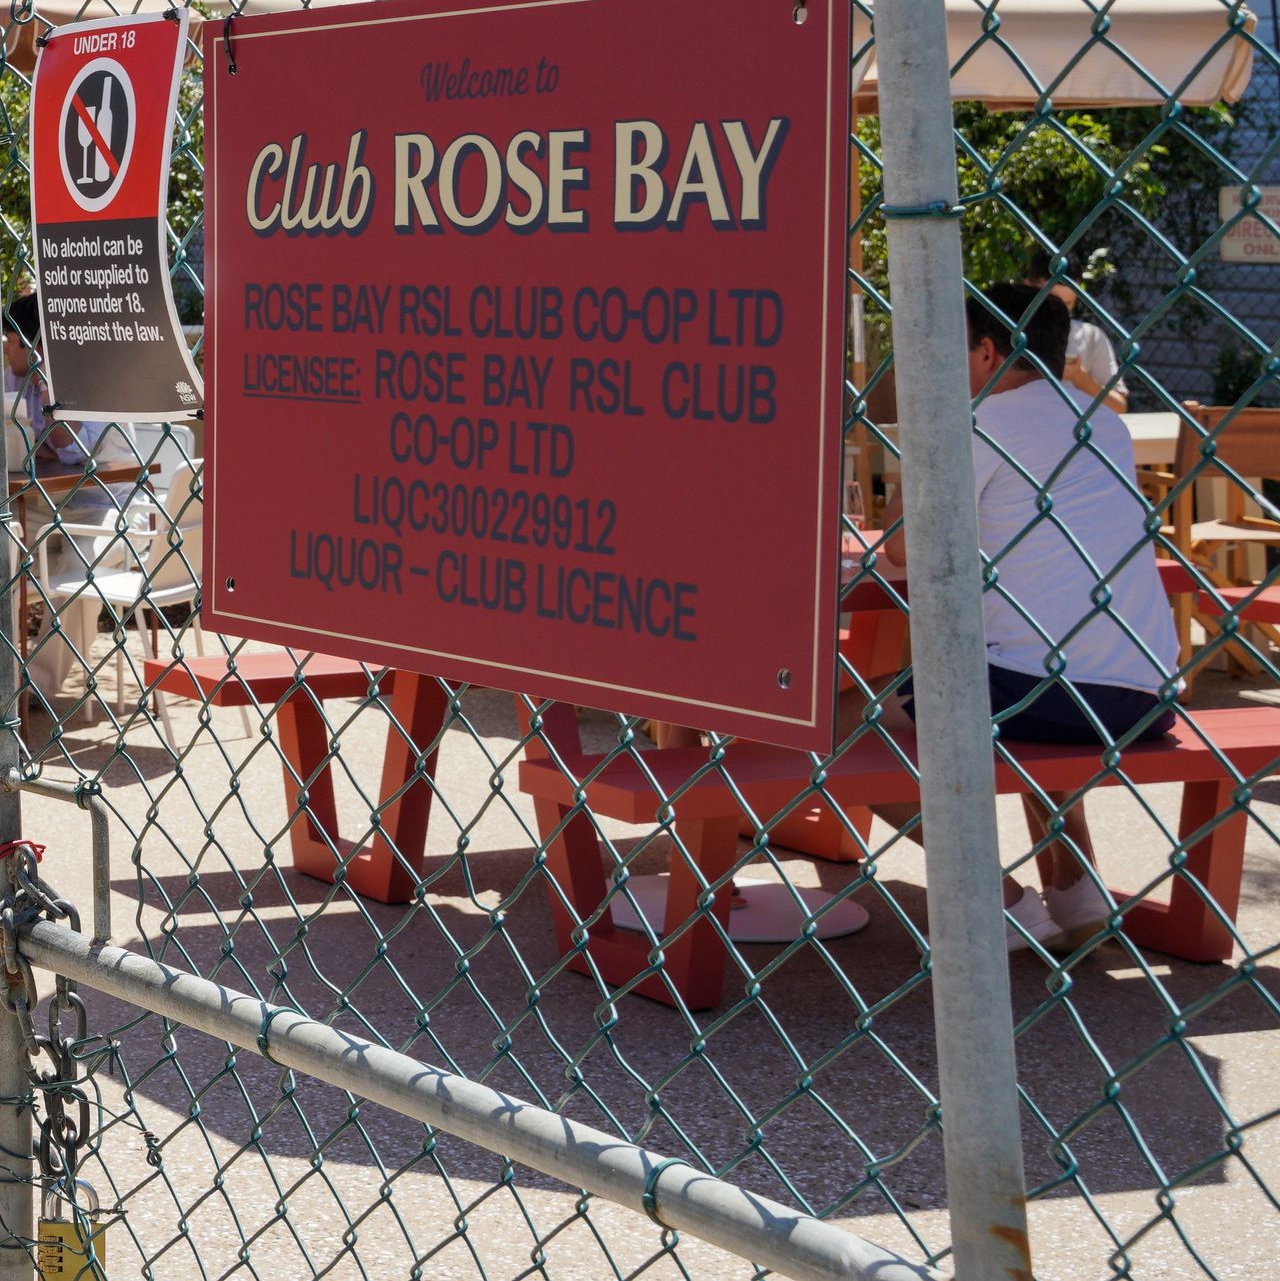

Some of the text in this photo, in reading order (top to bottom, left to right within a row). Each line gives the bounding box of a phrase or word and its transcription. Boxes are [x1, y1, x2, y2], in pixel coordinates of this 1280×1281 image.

[73, 31, 136, 55] UNDER 18
[420, 56, 560, 101] Welcome to
[246, 116, 791, 238] Club ROSE BAY
[42, 234, 143, 258] No alcohol can be
[1244, 242, 1279, 255] ONL
[45, 264, 149, 289] sold or supplied to
[48, 292, 145, 317] anyone under 18.
[244, 282, 784, 348] ROSE BAY RSL CLUB CO-OP LTD
[50, 320, 164, 345] It's against the law.
[243, 349, 777, 425] LICENSEE: ROSE BAY RSL CLUB
[390, 411, 575, 478] CO-OP LTD
[354, 474, 616, 555] LIQC300229912
[290, 529, 403, 594] LIQUOR
[436, 550, 527, 613] CLUB
[537, 563, 699, 642] LICENCE
